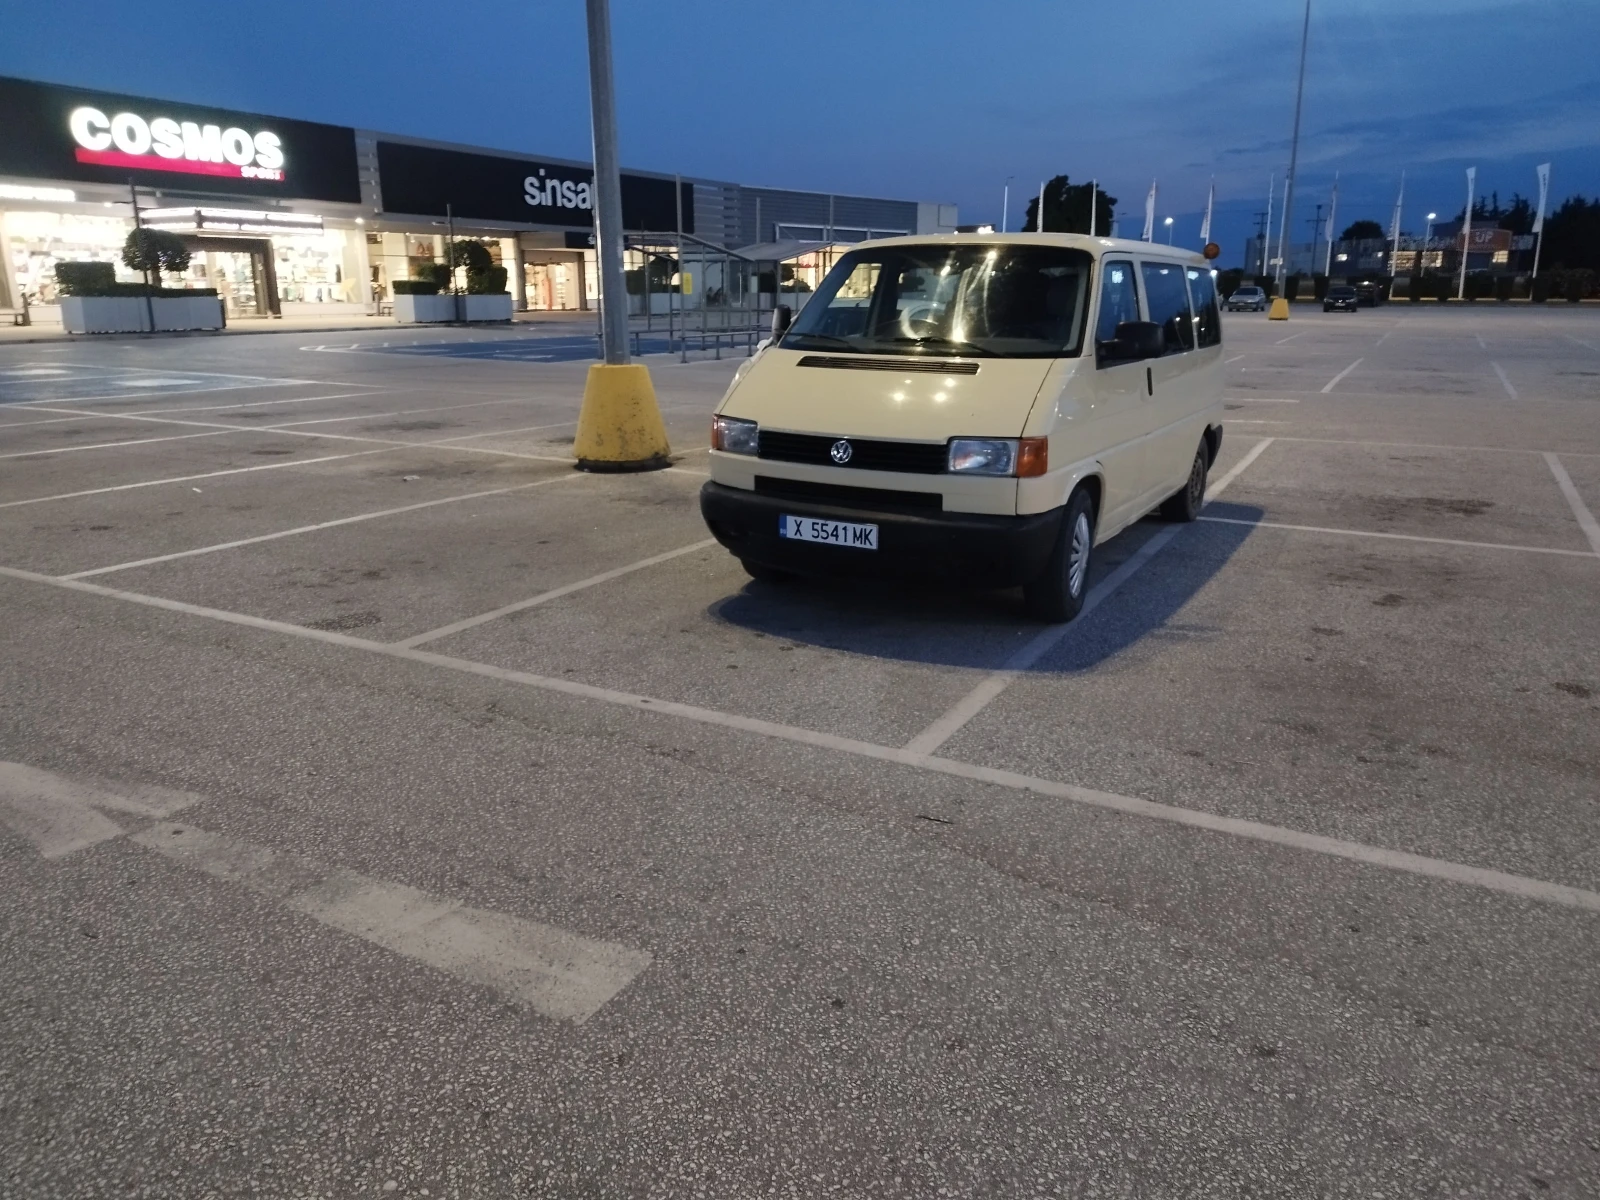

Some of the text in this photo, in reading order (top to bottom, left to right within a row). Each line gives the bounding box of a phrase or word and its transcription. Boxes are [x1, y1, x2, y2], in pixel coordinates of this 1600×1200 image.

[70, 106, 284, 169] COSMOS
[240, 166, 282, 180] SPORT
[523, 168, 596, 217] sinsa
[793, 519, 873, 547] X 5541 MK
